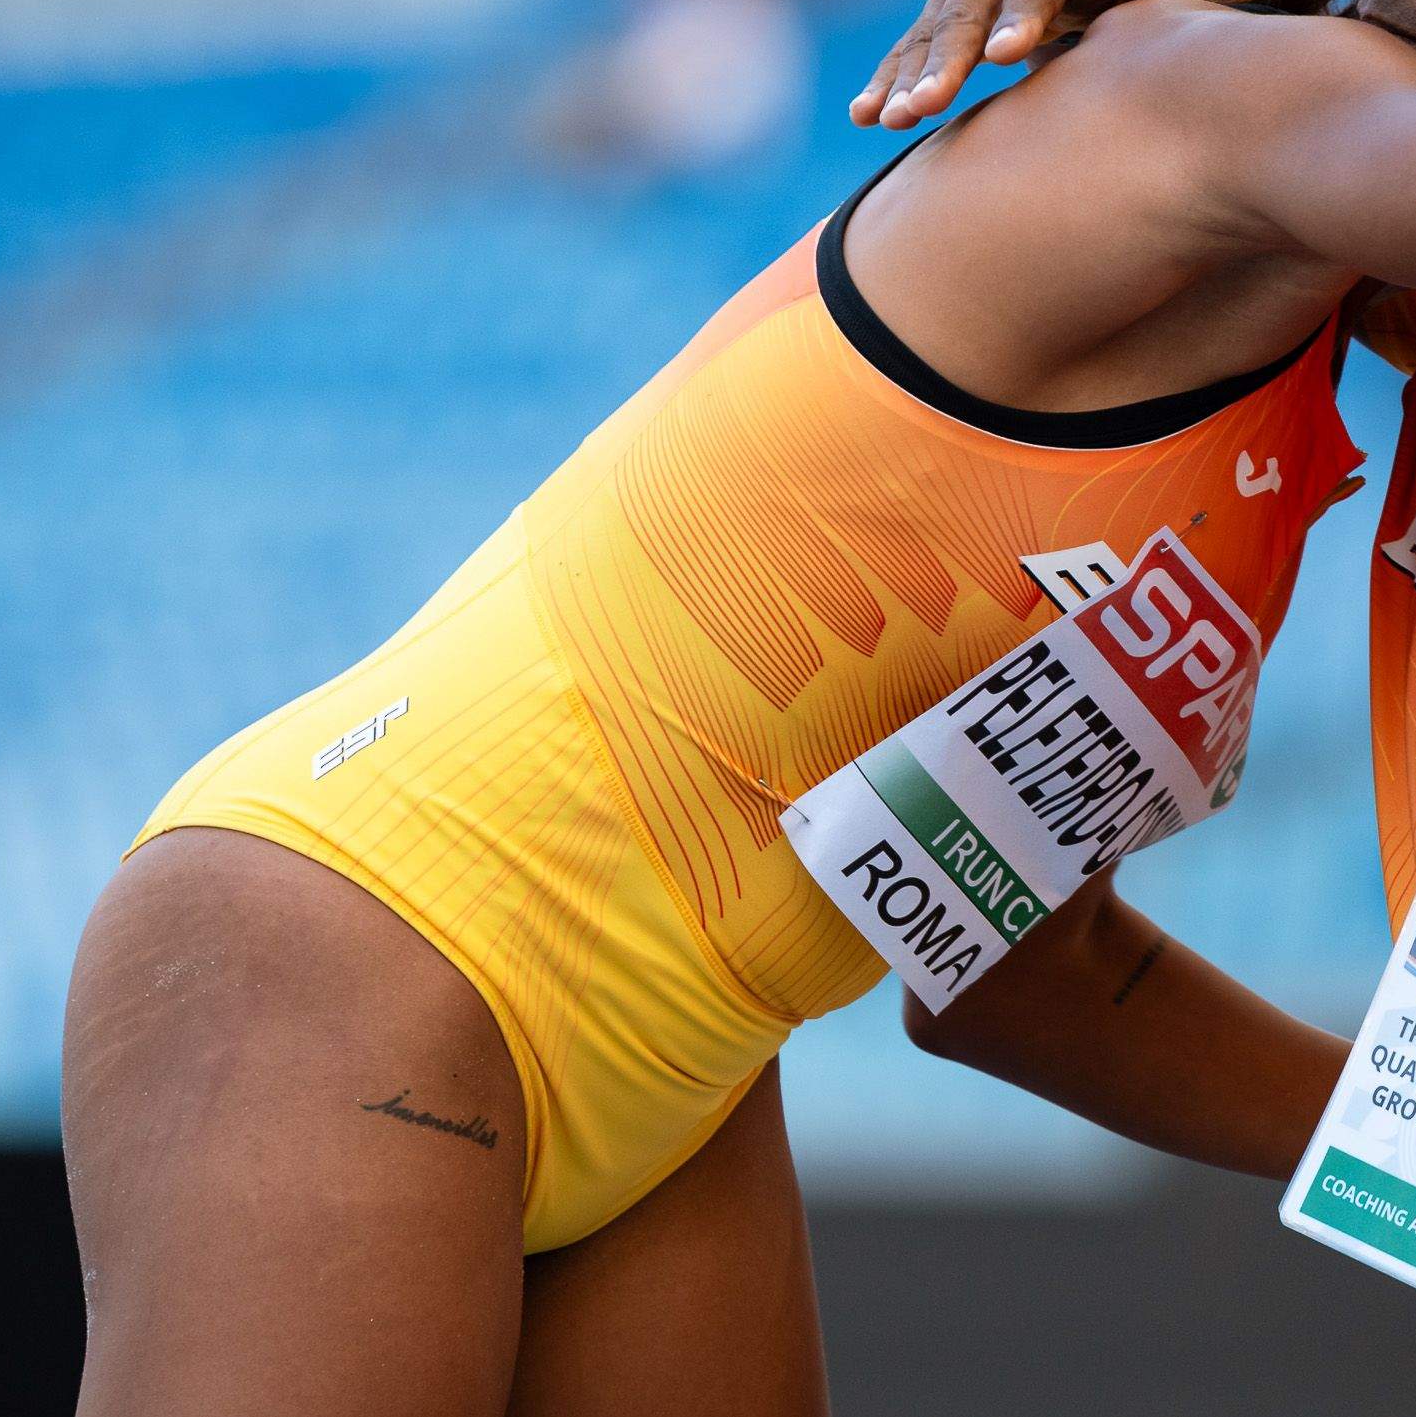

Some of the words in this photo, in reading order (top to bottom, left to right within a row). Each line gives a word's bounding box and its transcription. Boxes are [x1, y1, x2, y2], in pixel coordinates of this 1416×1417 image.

[1100, 567, 1255, 771] SPAR
[311, 696, 409, 781] ESP
[943, 830, 1015, 911] RUN
[841, 839, 983, 992] ROMA
[1322, 1173, 1407, 1228] COACHING
